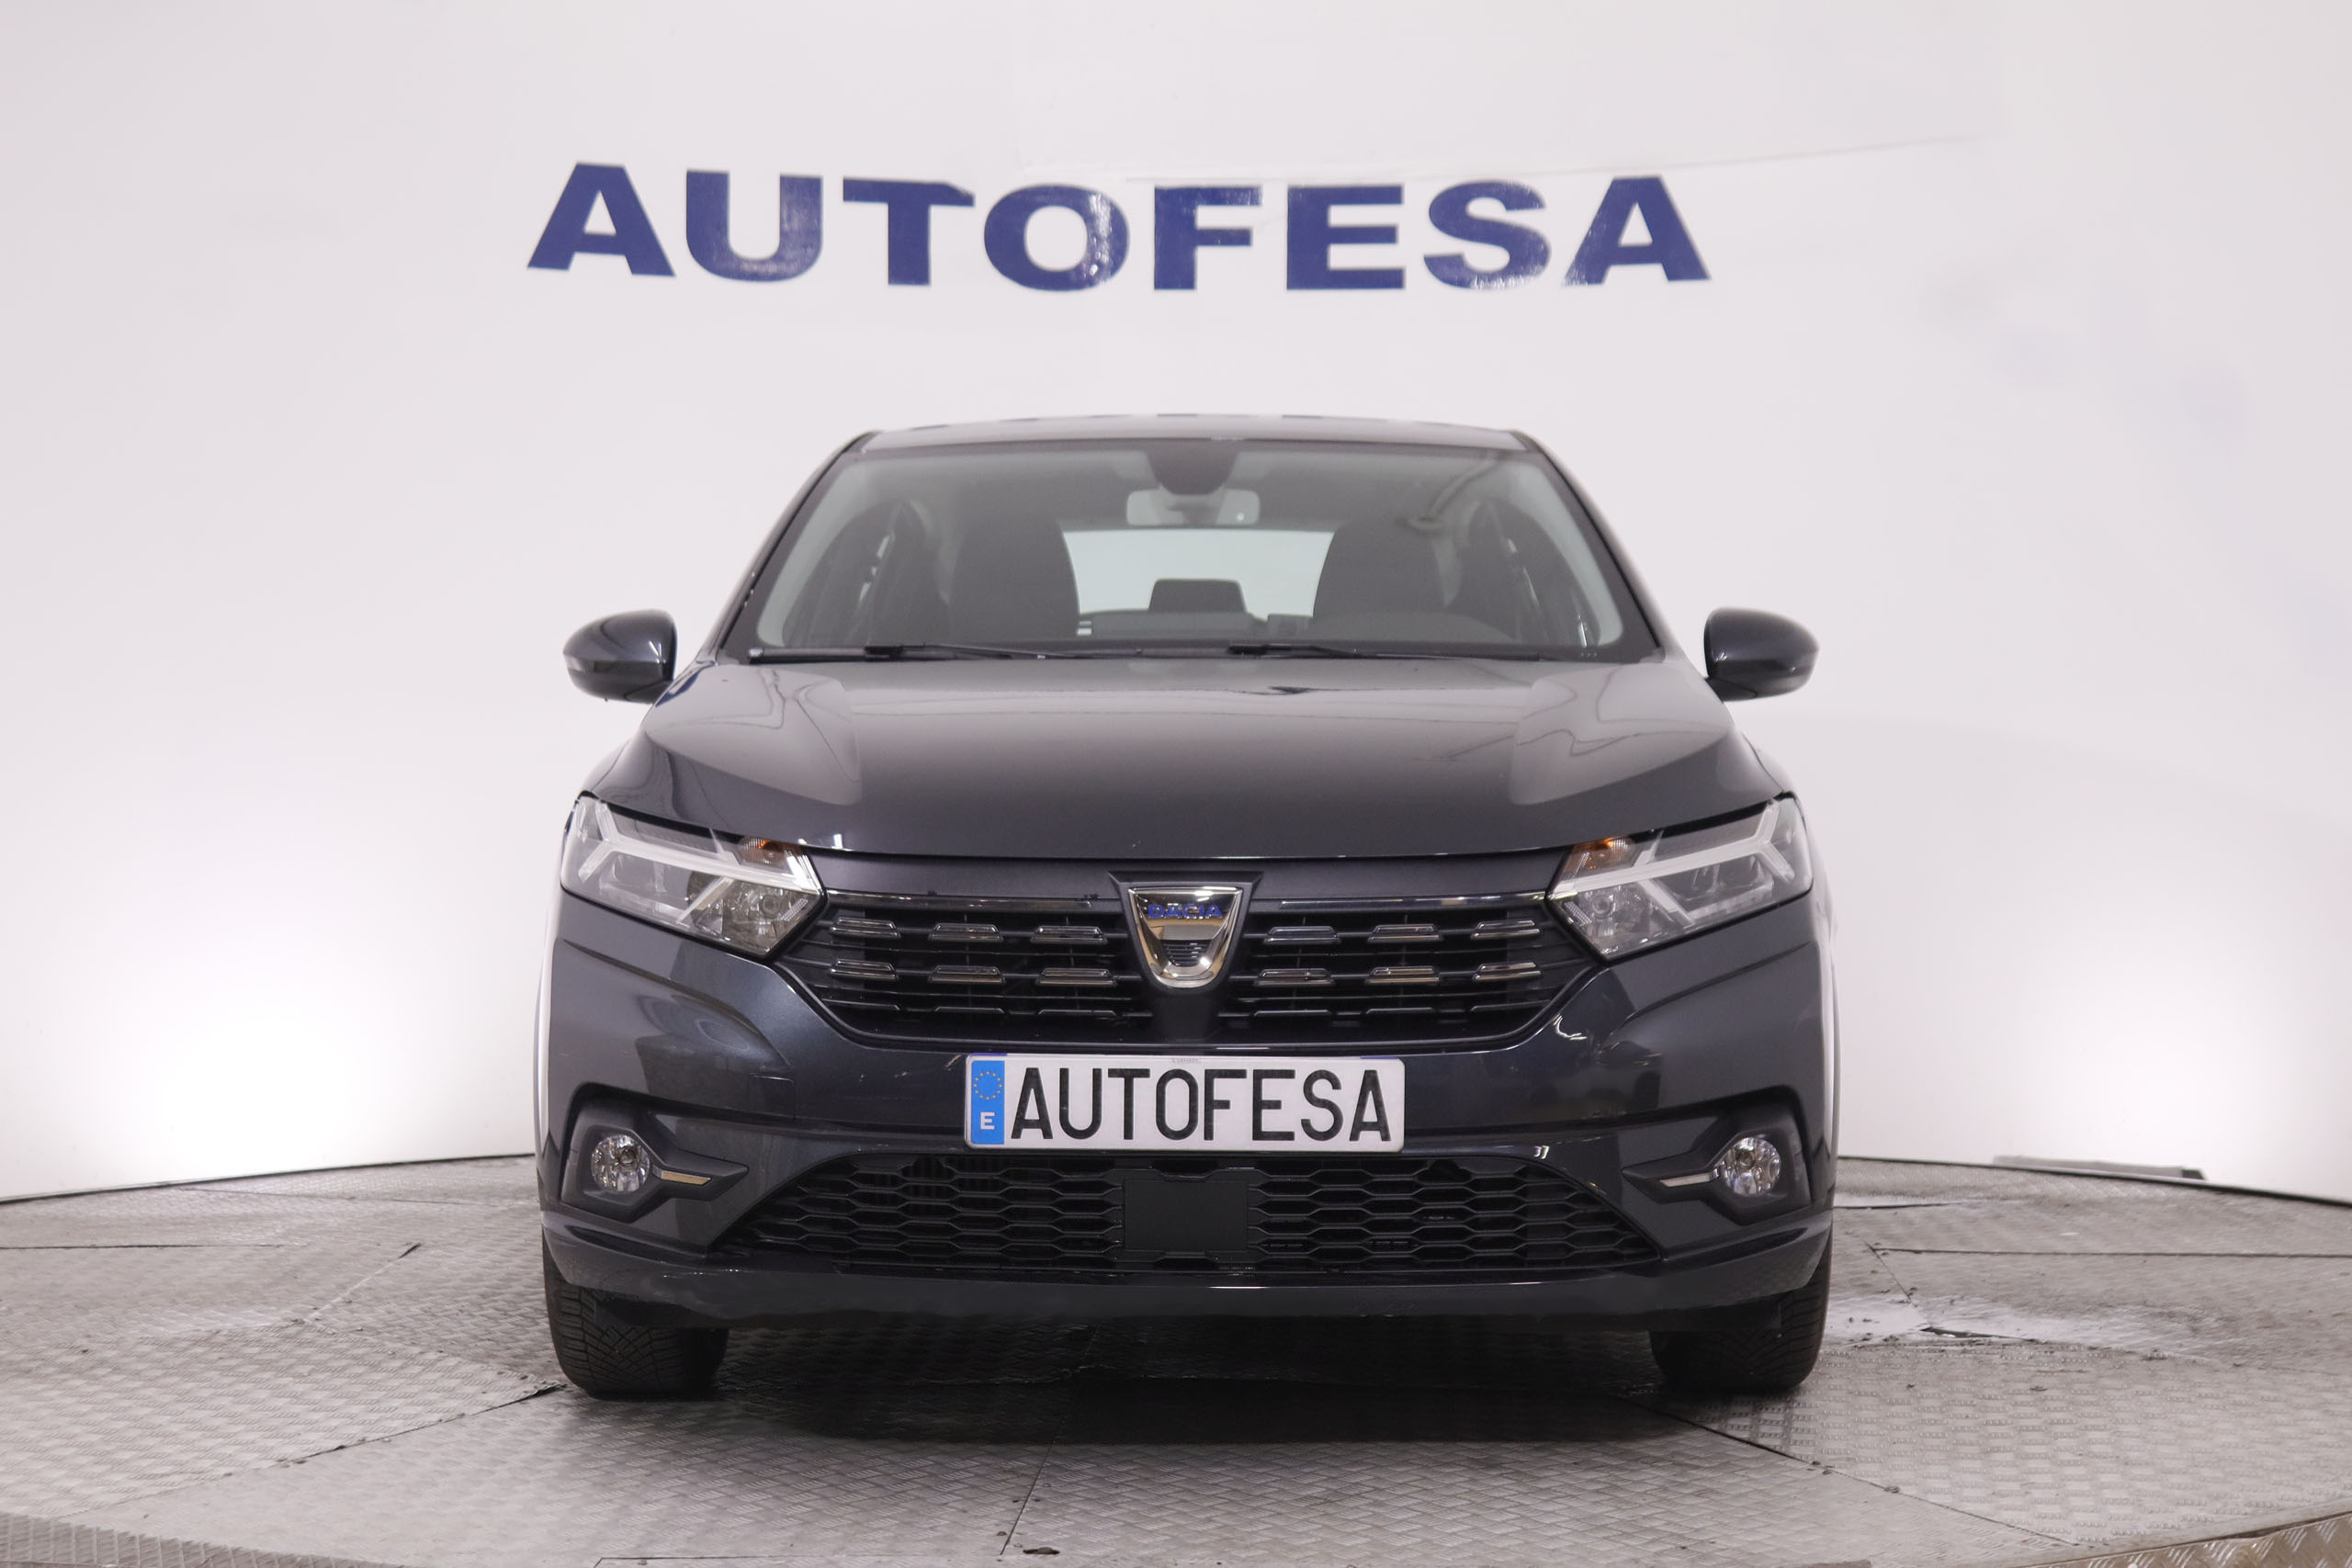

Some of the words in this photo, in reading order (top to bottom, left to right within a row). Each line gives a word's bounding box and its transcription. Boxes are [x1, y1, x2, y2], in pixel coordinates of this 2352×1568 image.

[528, 163, 1711, 291] AUTOFESA
[1148, 904, 1223, 919] DACIA
[979, 1112, 995, 1130] E
[1011, 1066, 1392, 1142] AUTOFESA
